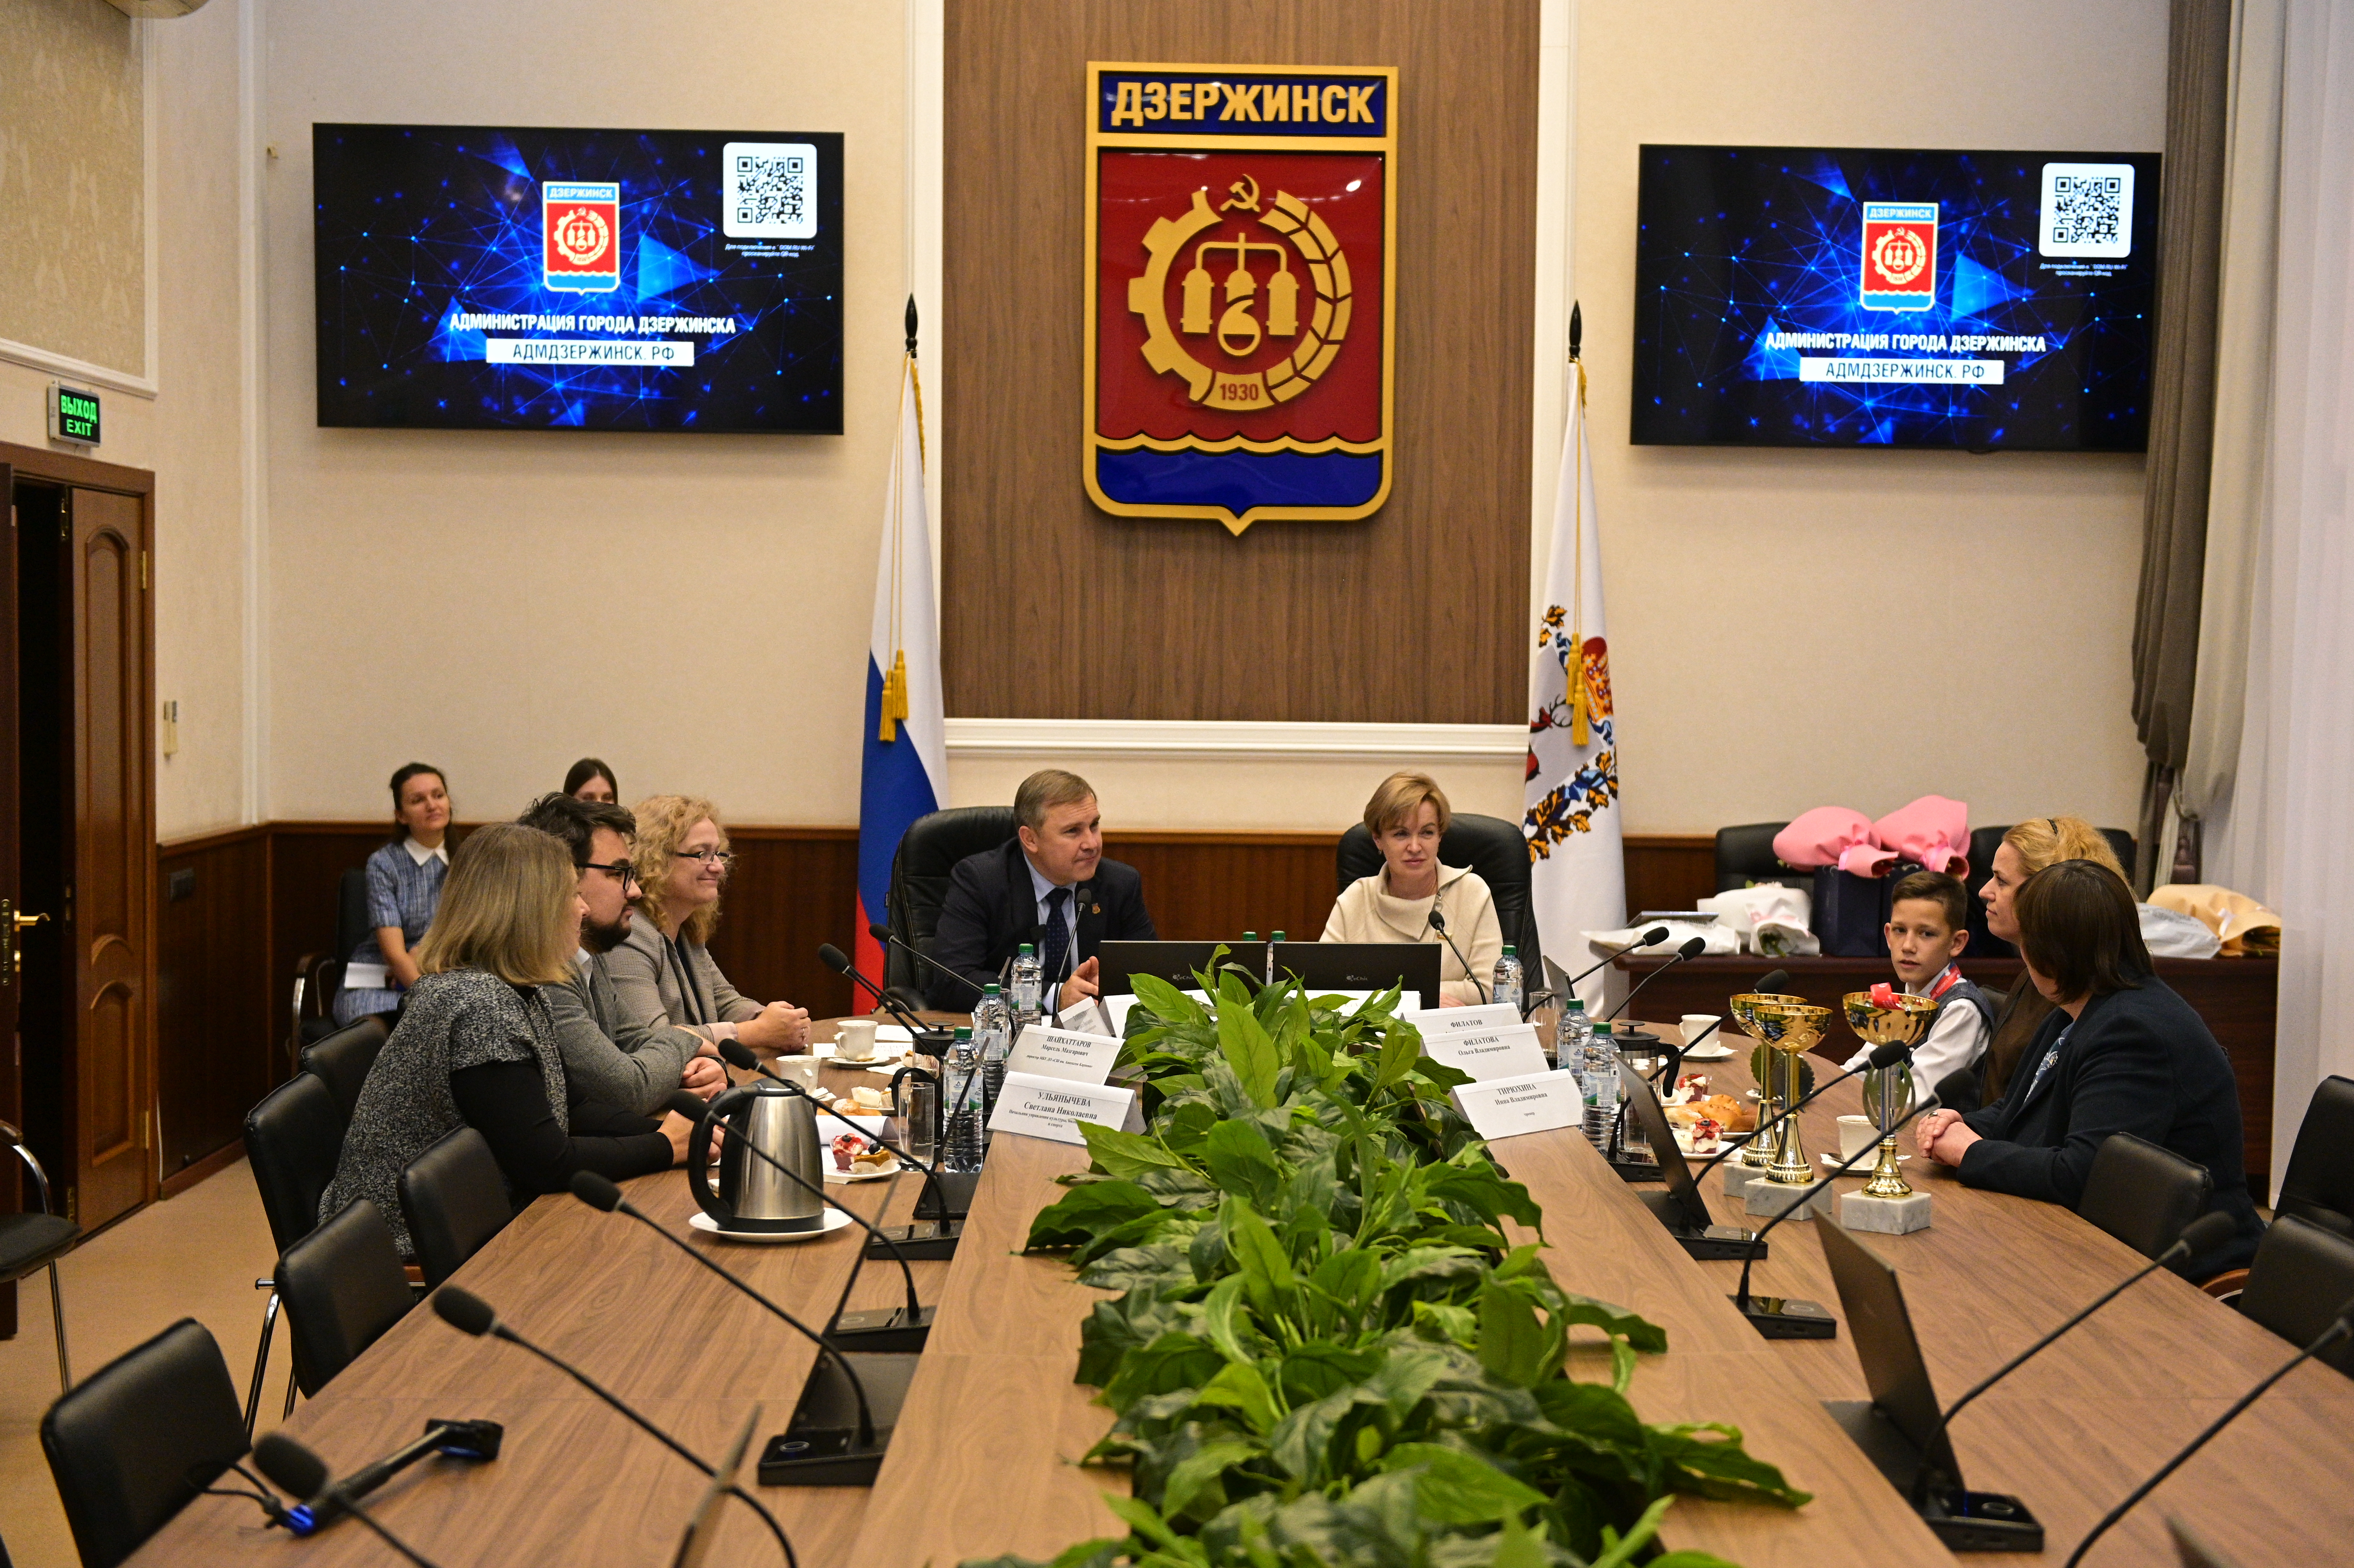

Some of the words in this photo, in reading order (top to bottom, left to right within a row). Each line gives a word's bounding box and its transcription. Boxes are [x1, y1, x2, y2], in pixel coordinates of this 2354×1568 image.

[1110, 82, 1375, 126] ДЗЕРЖИНСК
[549, 188, 613, 198] ДЗЕРЖИНСК
[1869, 208, 1932, 218] ДЗЕРЖИНСК
[450, 313, 575, 333] АДМИНИСТРАЦИЯ
[579, 315, 635, 334] ГОРОДА
[638, 316, 736, 335] ДЗЕРЖИНСКА
[1766, 333, 1889, 351] АДМИНИСТРАЦИЯ
[1892, 334, 1947, 352] ГОРОДА
[1950, 335, 2046, 353] ДЗЕРЖИНСКА
[1220, 383, 1259, 401] 1930
[61, 395, 98, 424] ВЫХОД
[67, 419, 93, 436] EXIT
[1450, 1020, 1483, 1028] ФИЛАТОВ
[1047, 1036, 1092, 1048] ШАЙХАТТАРОВ
[1463, 1036, 1499, 1047] ФИЛАТОВА
[1041, 1044, 1061, 1052] Марсель
[1061, 1047, 1089, 1056] Мазгарович
[1474, 1045, 1510, 1054] Владимировна
[1496, 1083, 1537, 1095] ТИРЮХИНА
[1038, 1091, 1091, 1107] УЛЬЯНЫЧЕВА
[1510, 1092, 1548, 1102] Владимировна
[1024, 1101, 1055, 1114] Светлана
[1056, 1107, 1097, 1119] Николаевна
